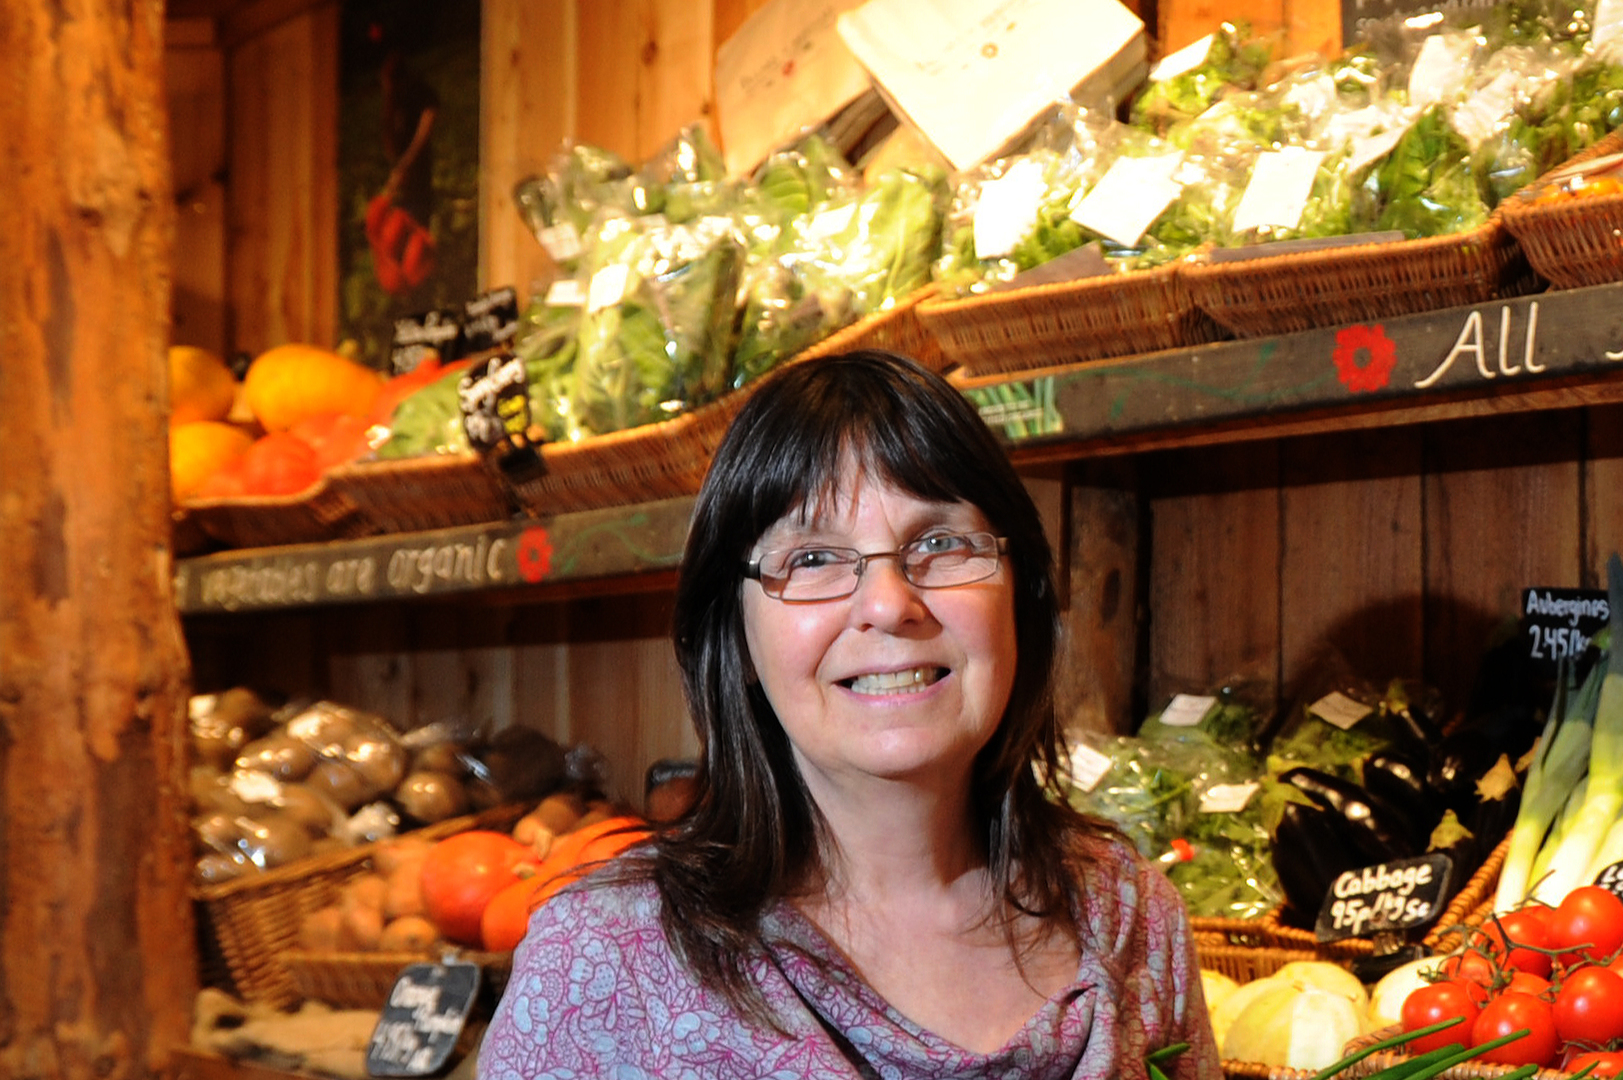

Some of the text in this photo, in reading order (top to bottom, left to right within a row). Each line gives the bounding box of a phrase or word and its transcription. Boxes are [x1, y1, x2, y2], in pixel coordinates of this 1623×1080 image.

[1414, 301, 1546, 389] All
[326, 556, 375, 595] are
[387, 534, 507, 595] organic
[1526, 589, 1610, 627] Aubergines
[1334, 863, 1433, 898] Cabbage
